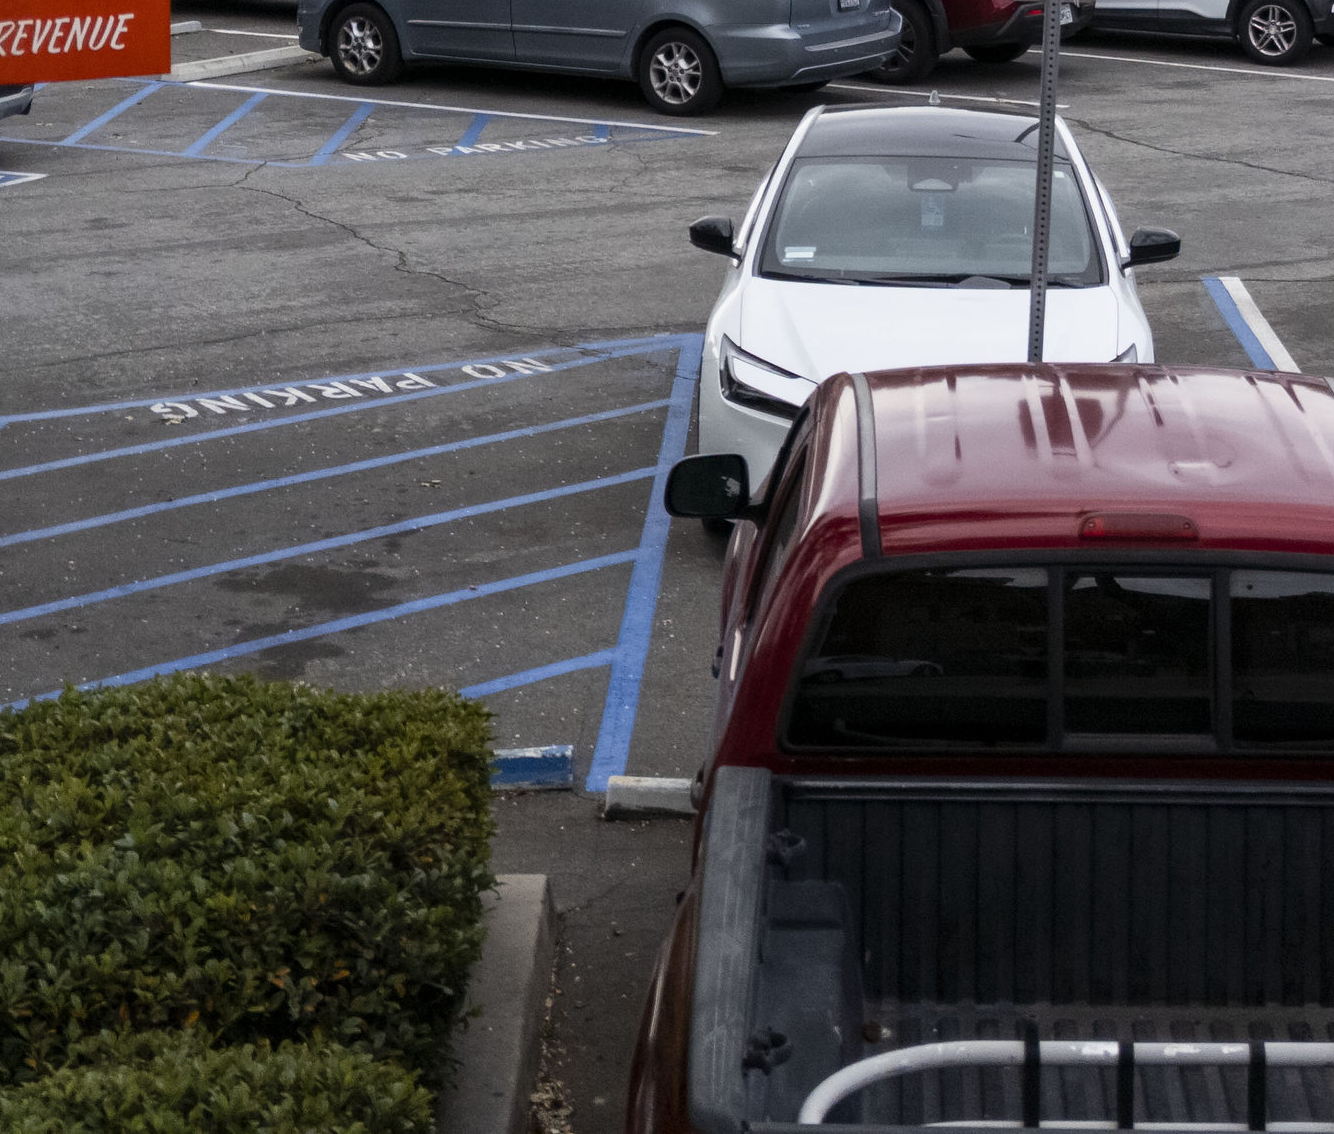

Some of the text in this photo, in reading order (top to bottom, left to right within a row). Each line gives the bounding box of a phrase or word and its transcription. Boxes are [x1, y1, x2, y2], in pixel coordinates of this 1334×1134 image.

[341, 135, 612, 163] NO PARKING
[150, 357, 555, 421] NO PARKING
